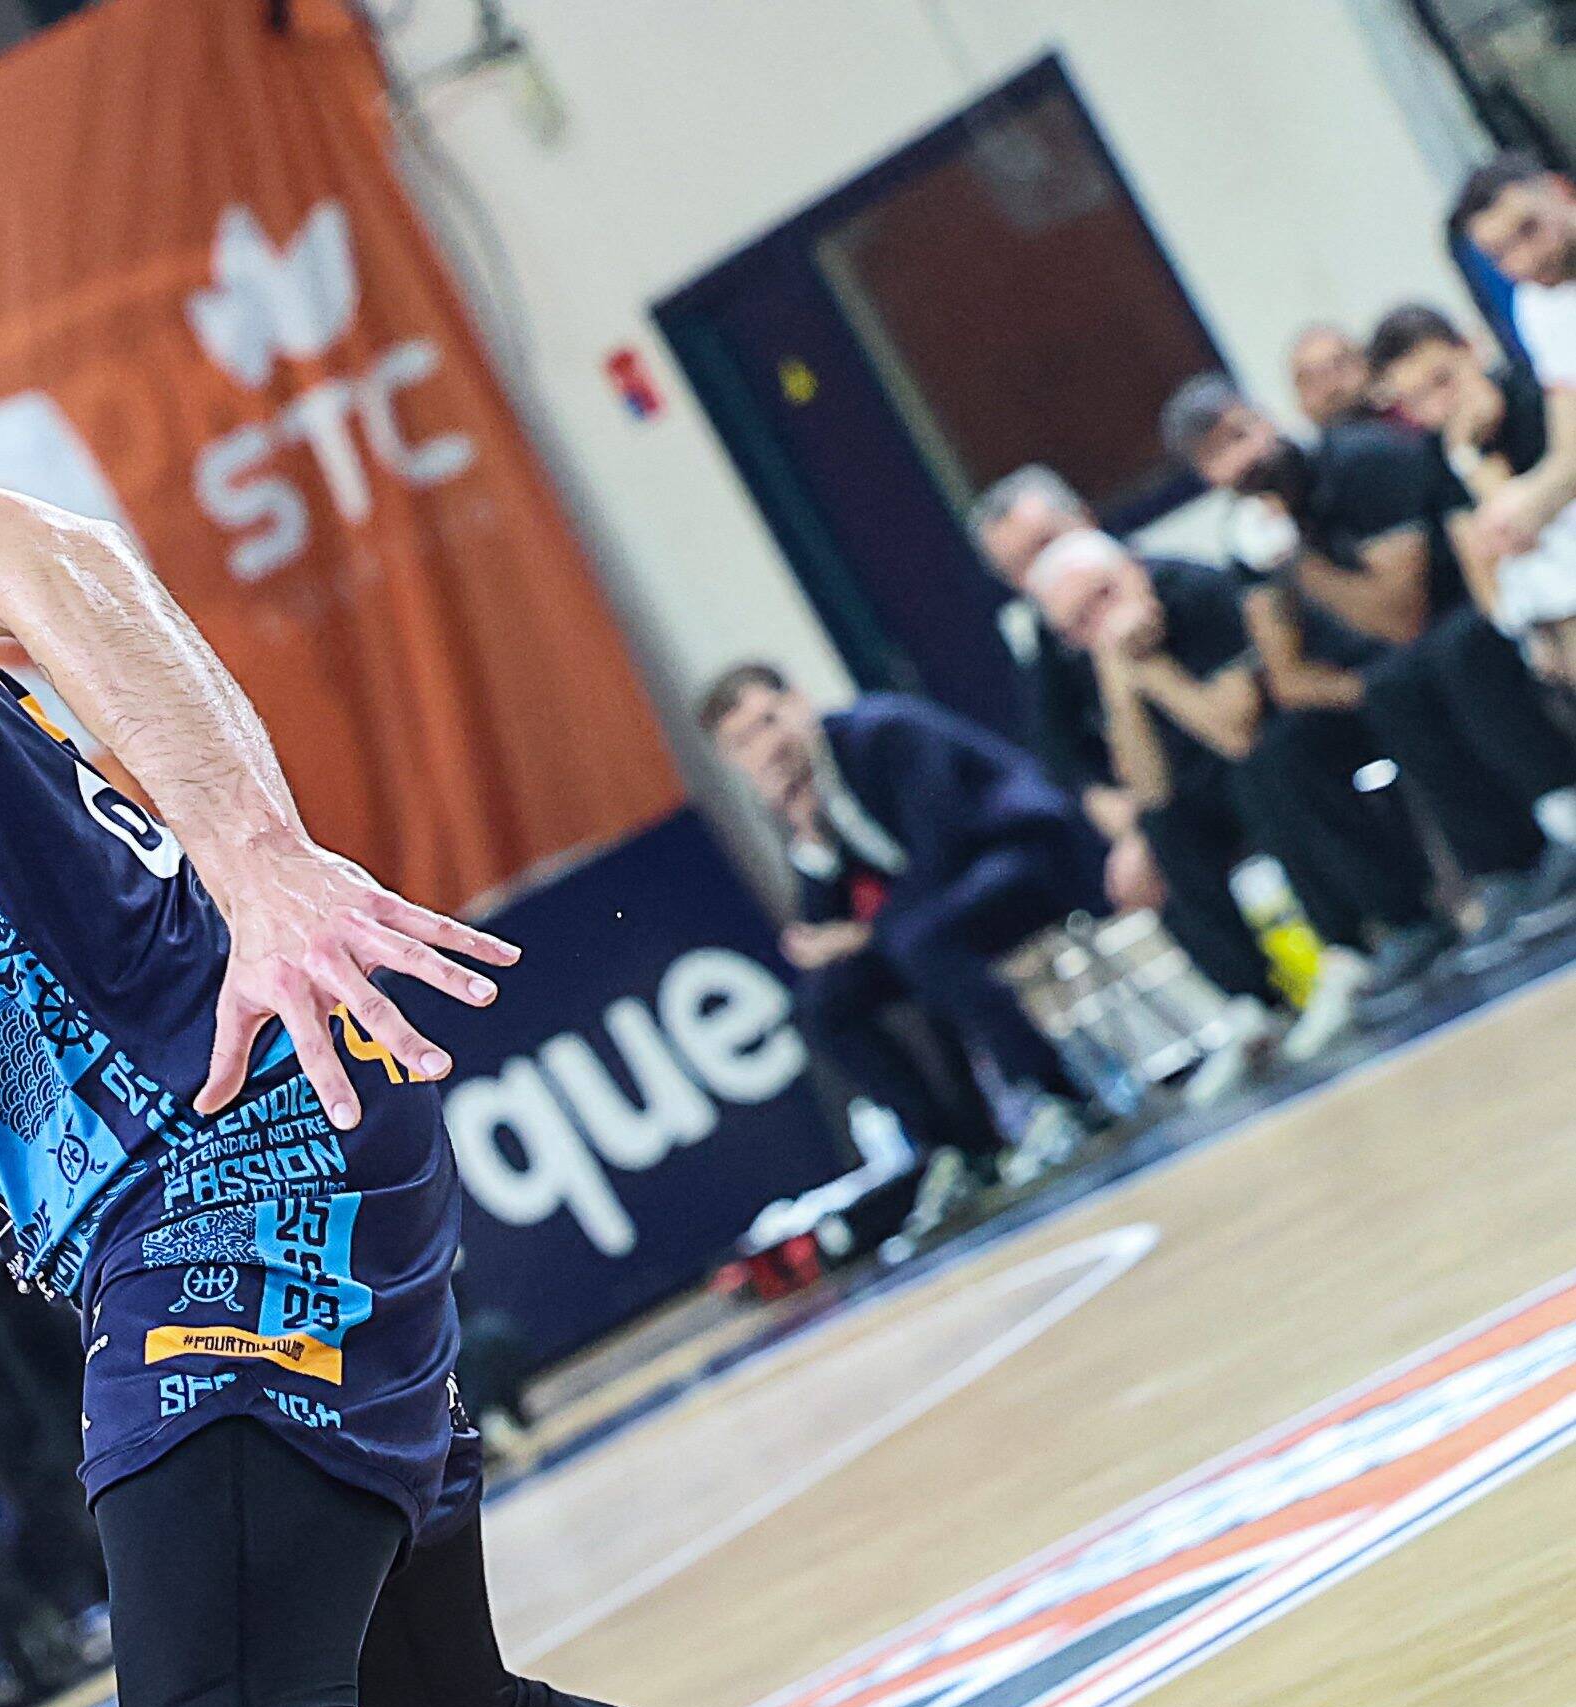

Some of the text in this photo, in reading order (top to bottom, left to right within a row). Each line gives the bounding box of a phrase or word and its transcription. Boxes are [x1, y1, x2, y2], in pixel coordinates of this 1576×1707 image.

[196, 338, 475, 580] STC
[268, 1116, 330, 1148] NOTRE
[163, 1135, 347, 1210] PASSION
